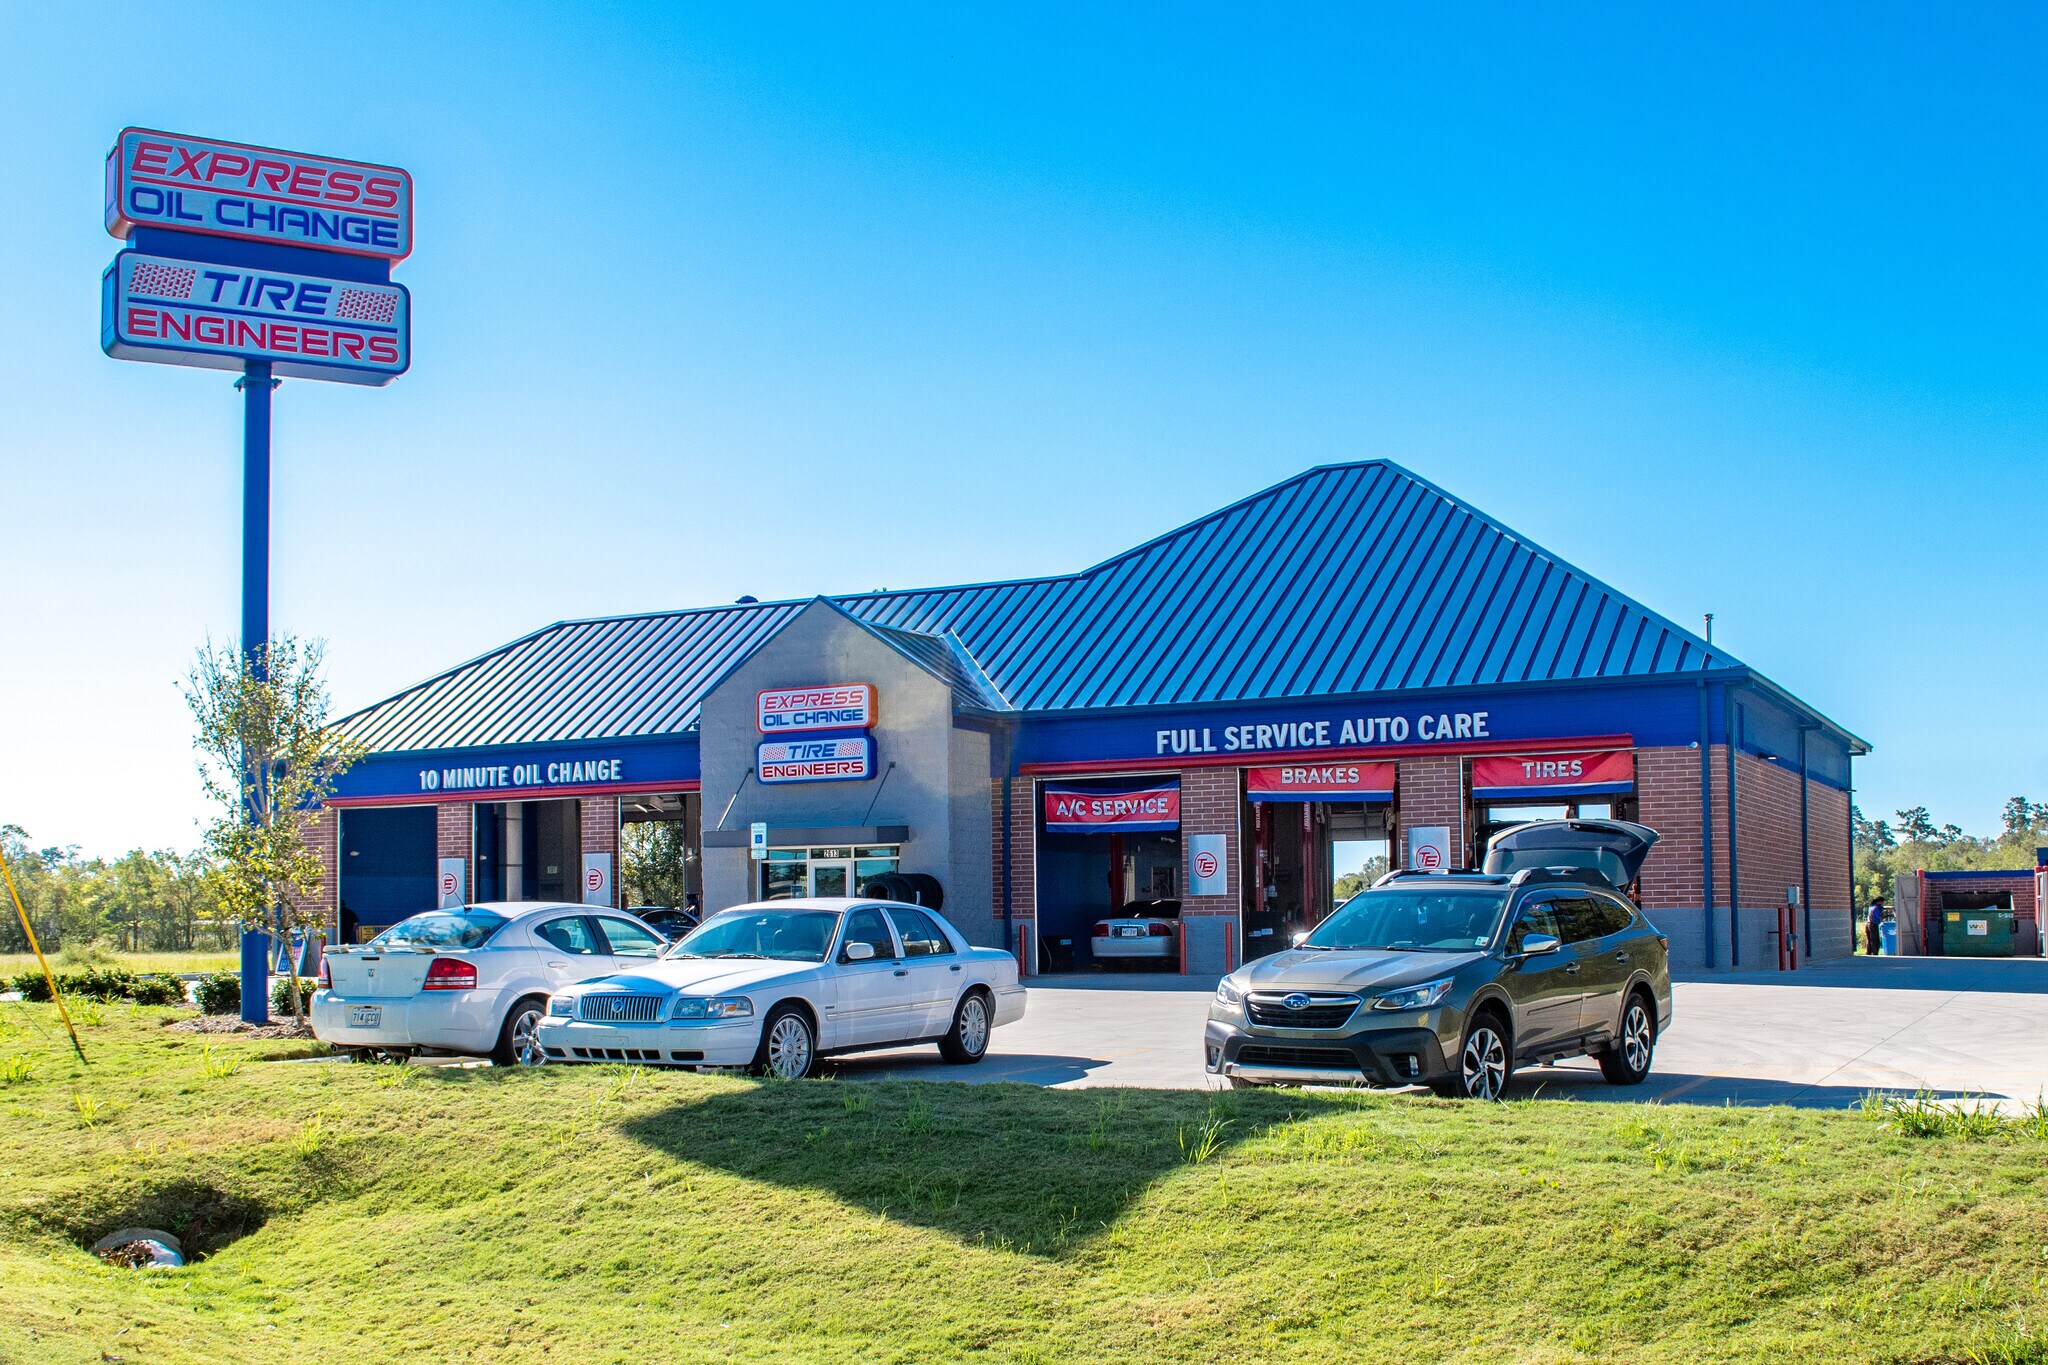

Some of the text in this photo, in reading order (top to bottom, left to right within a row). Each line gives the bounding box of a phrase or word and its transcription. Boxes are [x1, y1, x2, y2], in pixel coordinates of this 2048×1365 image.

[131, 141, 401, 208] EXPRESS
[130, 186, 399, 249] OIL CHANGE
[203, 270, 333, 315] TIRE
[127, 307, 399, 364] ENGINEERS
[764, 690, 864, 710] EXPRESS
[763, 709, 864, 727] OIL CHANGE
[1156, 711, 1490, 754] FULL SERVICE AUTO CARE
[788, 742, 838, 759] TIRE
[419, 759, 623, 790] 10 MINUTE OIL CHANGE
[762, 761, 864, 778] ENGINEERS
[1280, 767, 1360, 784] BRAKES
[1521, 760, 1583, 779] TIRES
[1056, 797, 1169, 818] A/C SERVICE
[1197, 858, 1215, 873] TE
[1419, 851, 1439, 867] TE
